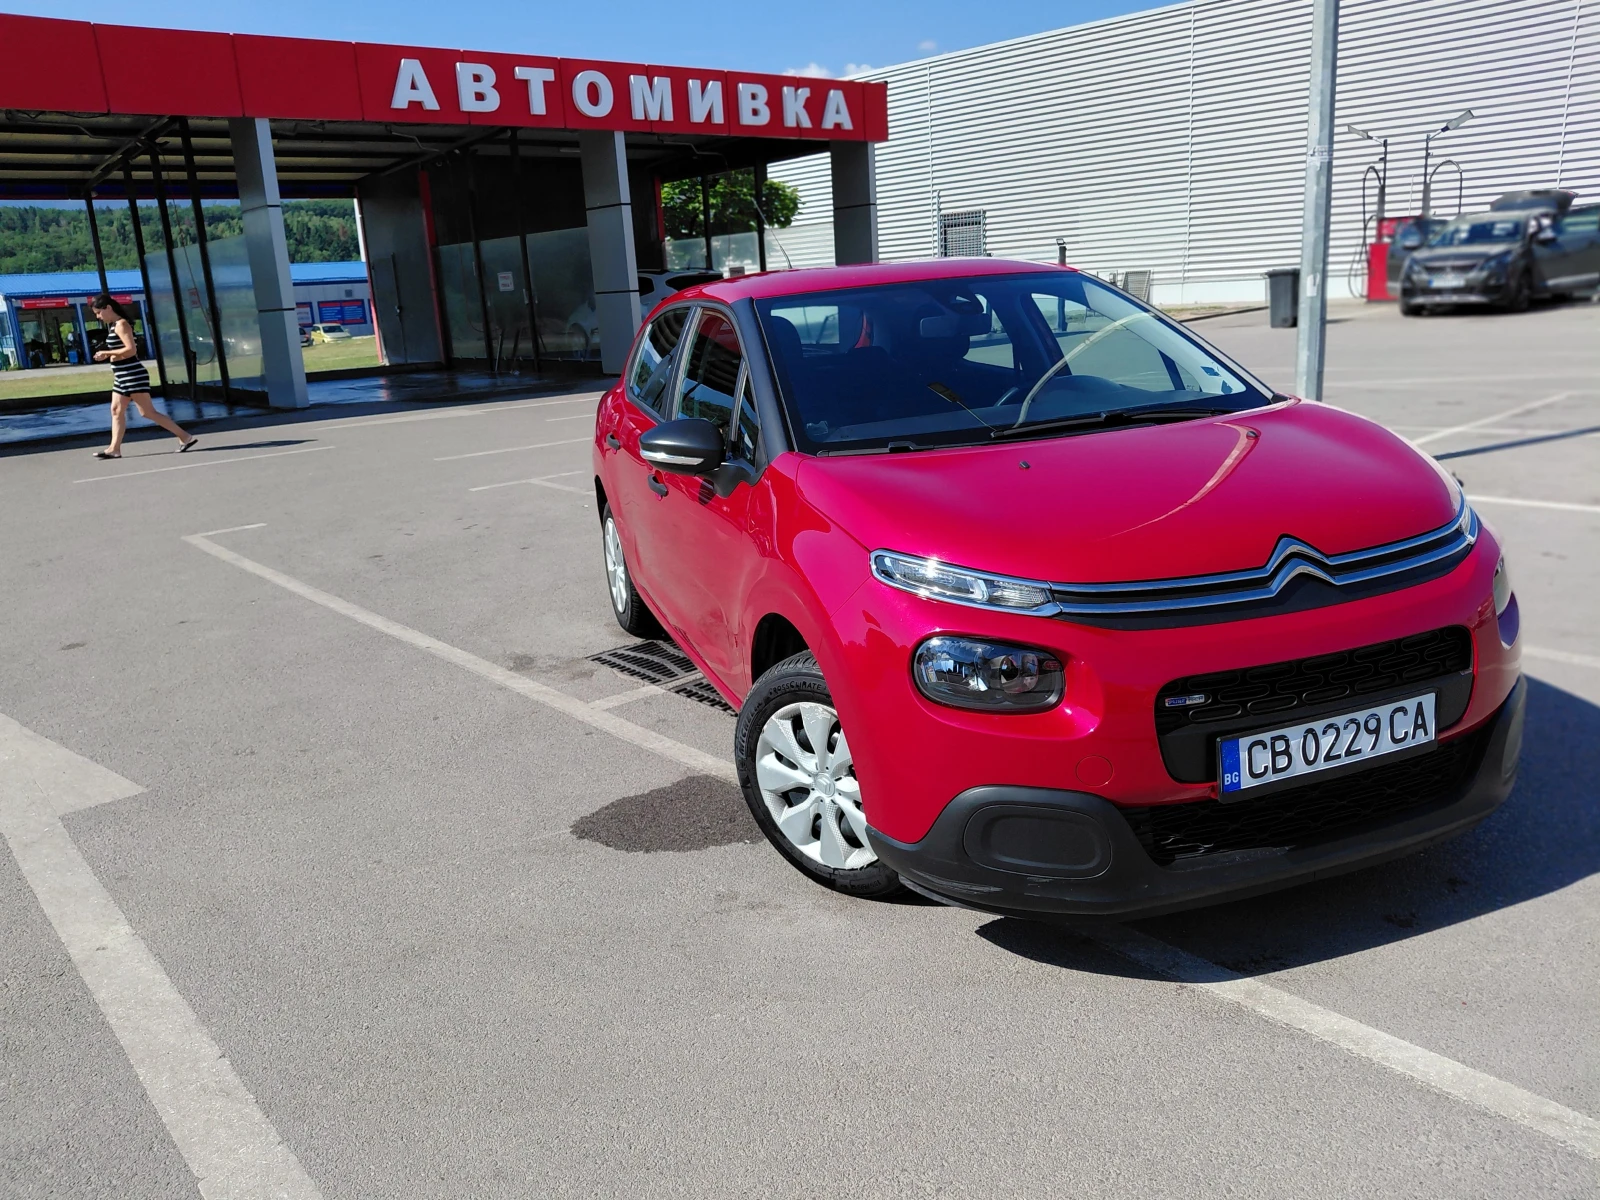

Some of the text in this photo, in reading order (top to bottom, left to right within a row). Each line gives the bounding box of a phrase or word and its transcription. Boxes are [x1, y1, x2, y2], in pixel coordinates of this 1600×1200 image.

[390, 58, 855, 131] АВТОМИВКА
[1247, 700, 1429, 780] CB 0229 CA
[1224, 772, 1240, 786] BG
